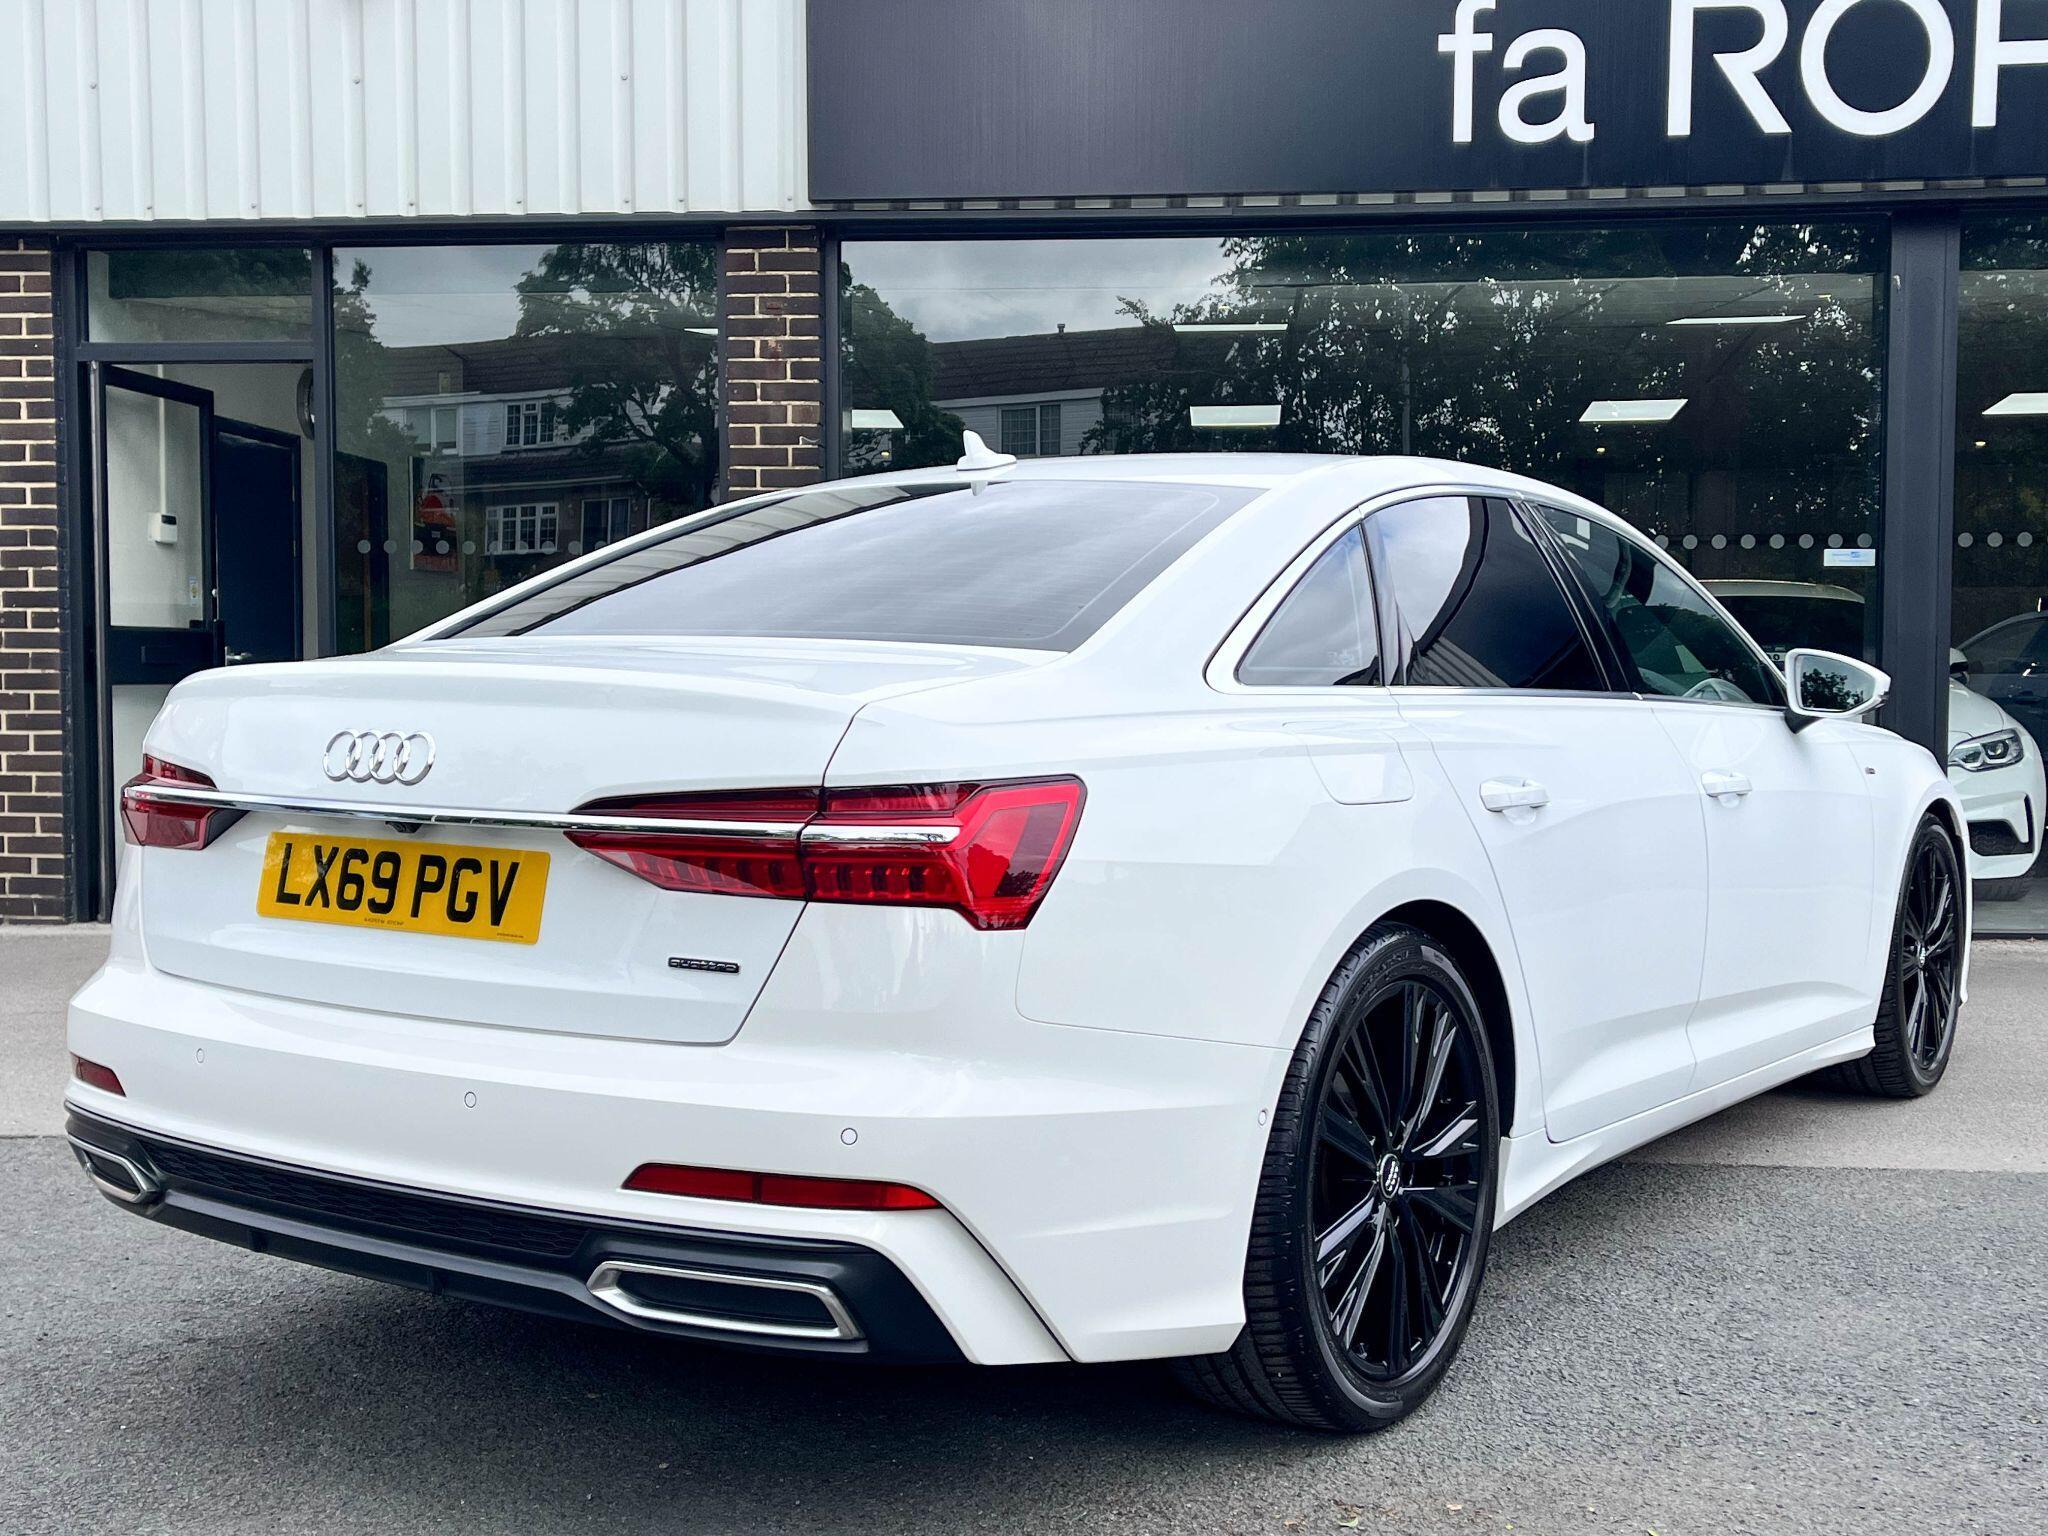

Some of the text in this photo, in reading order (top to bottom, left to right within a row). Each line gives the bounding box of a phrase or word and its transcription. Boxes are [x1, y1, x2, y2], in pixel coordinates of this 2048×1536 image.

[1438, 0, 1594, 144] fa
[275, 842, 520, 927] LX69 PGV
